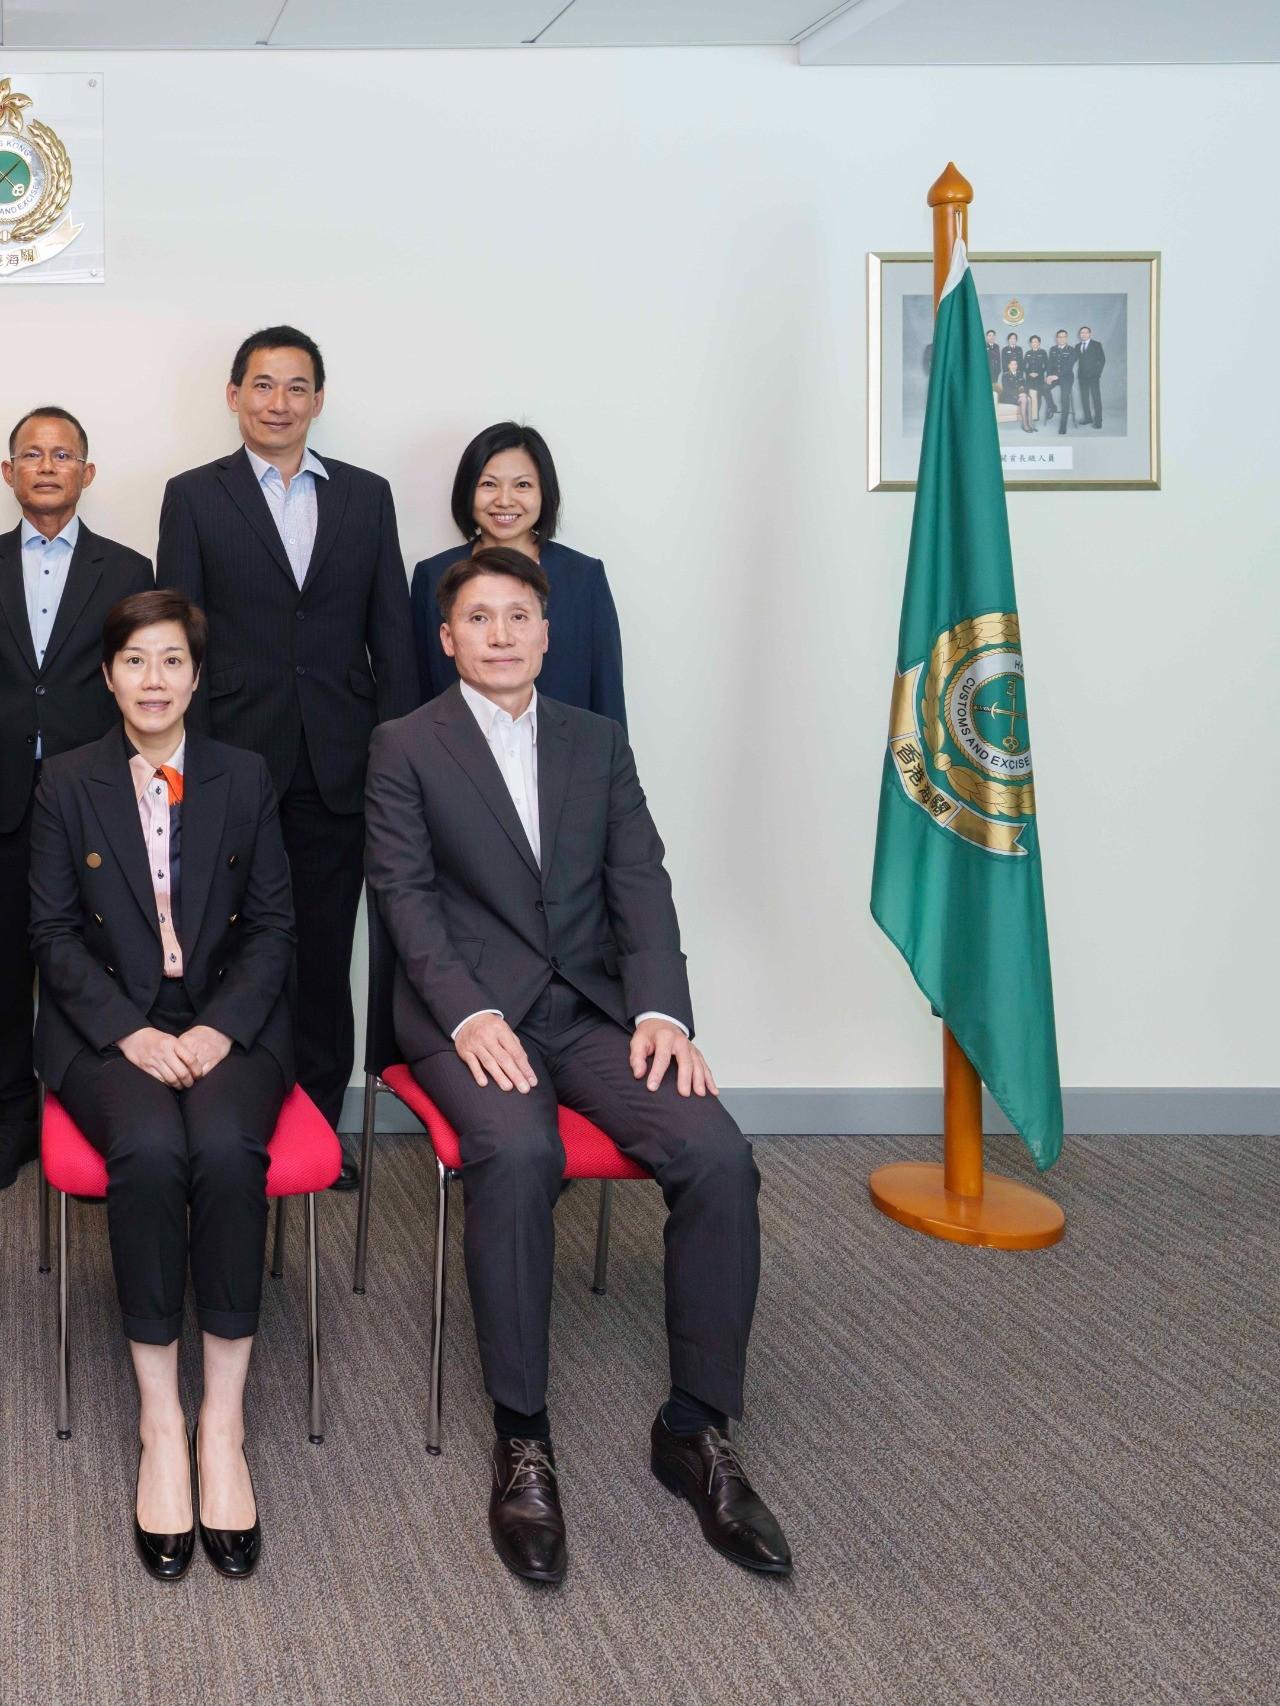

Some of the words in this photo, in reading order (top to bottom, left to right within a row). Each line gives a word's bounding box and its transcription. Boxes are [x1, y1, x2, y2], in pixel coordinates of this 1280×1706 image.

[6, 141, 32, 156] KONG
[0, 207, 17, 215] AND
[17, 184, 39, 210] EXCISE
[957, 677, 976, 736] CUSTOMS
[966, 738, 989, 760] AND
[990, 755, 1031, 770] EXCISE
[896, 743, 952, 817] 香港海關
